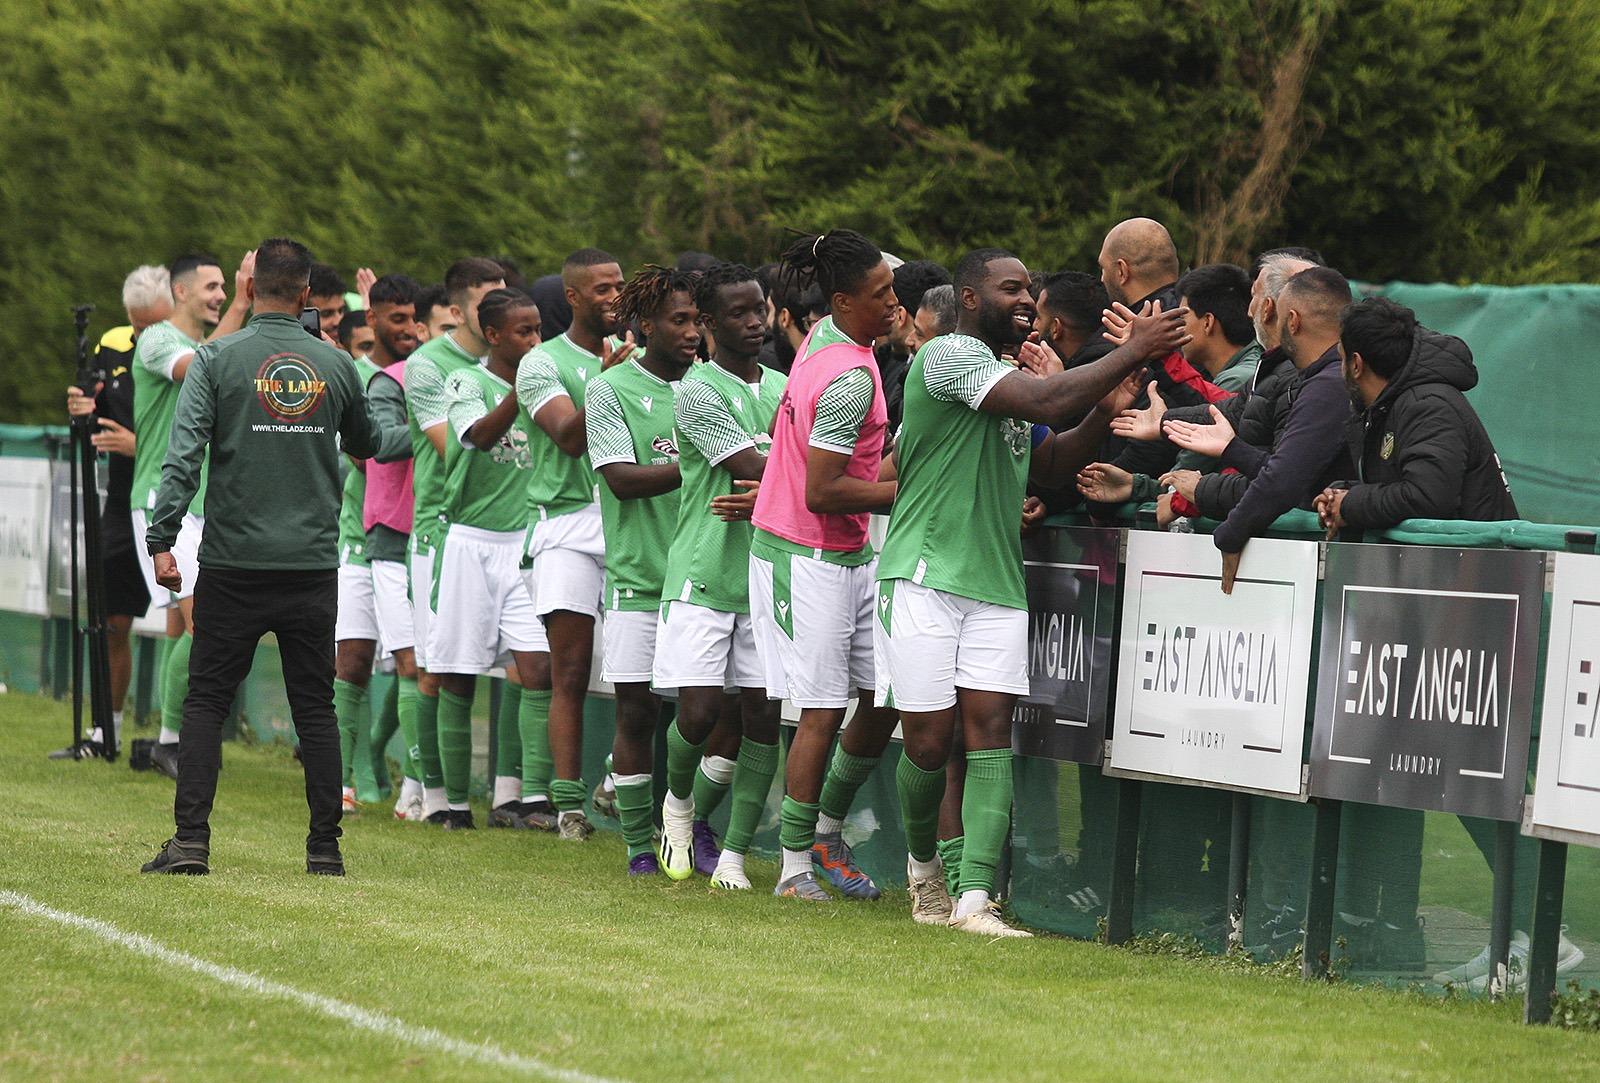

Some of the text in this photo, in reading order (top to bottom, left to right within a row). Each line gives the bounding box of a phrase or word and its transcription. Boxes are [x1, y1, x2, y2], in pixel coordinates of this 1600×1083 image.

[253, 378, 327, 394] THE LADZ
[1030, 612, 1084, 682] NGLIA
[1142, 623, 1277, 705] EAST ANGLIA
[1344, 640, 1409, 718] EAST
[1410, 647, 1499, 728] ANGLIA
[1181, 727, 1226, 750] LAUNDRY
[1389, 753, 1441, 776] LAUNDRY
